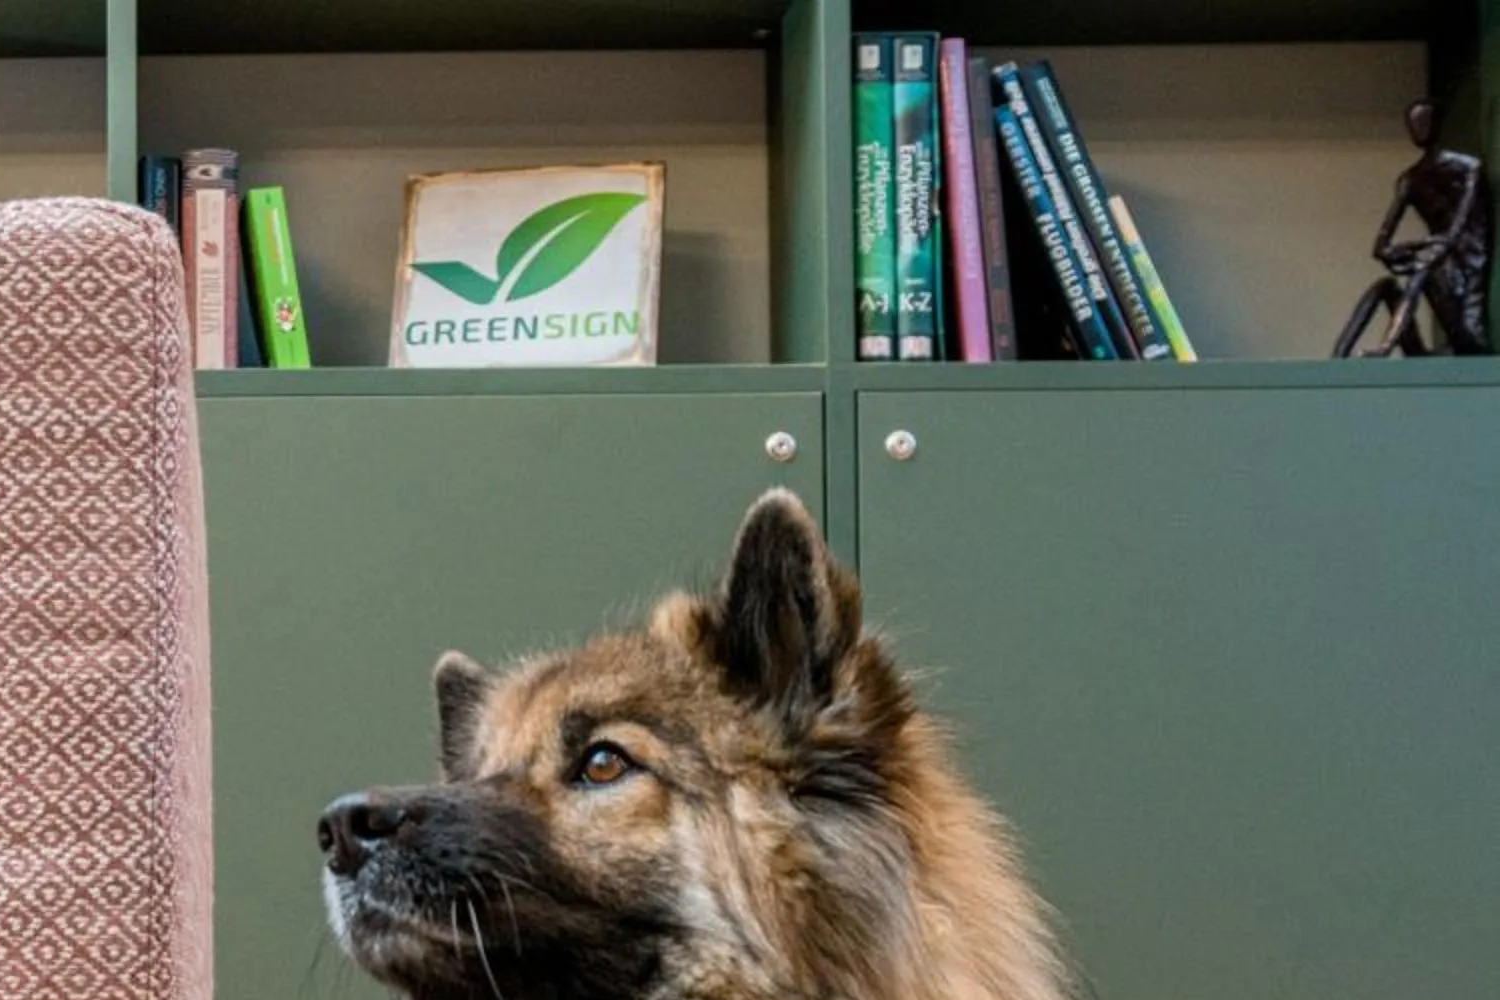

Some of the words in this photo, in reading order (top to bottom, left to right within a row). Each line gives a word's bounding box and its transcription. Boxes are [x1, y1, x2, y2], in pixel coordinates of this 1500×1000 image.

[1058, 131, 1082, 163] DIE
[1036, 212, 1092, 322] FLUGBILDER
[899, 291, 932, 313] K-Z
[404, 309, 641, 346] GREENSIGN
